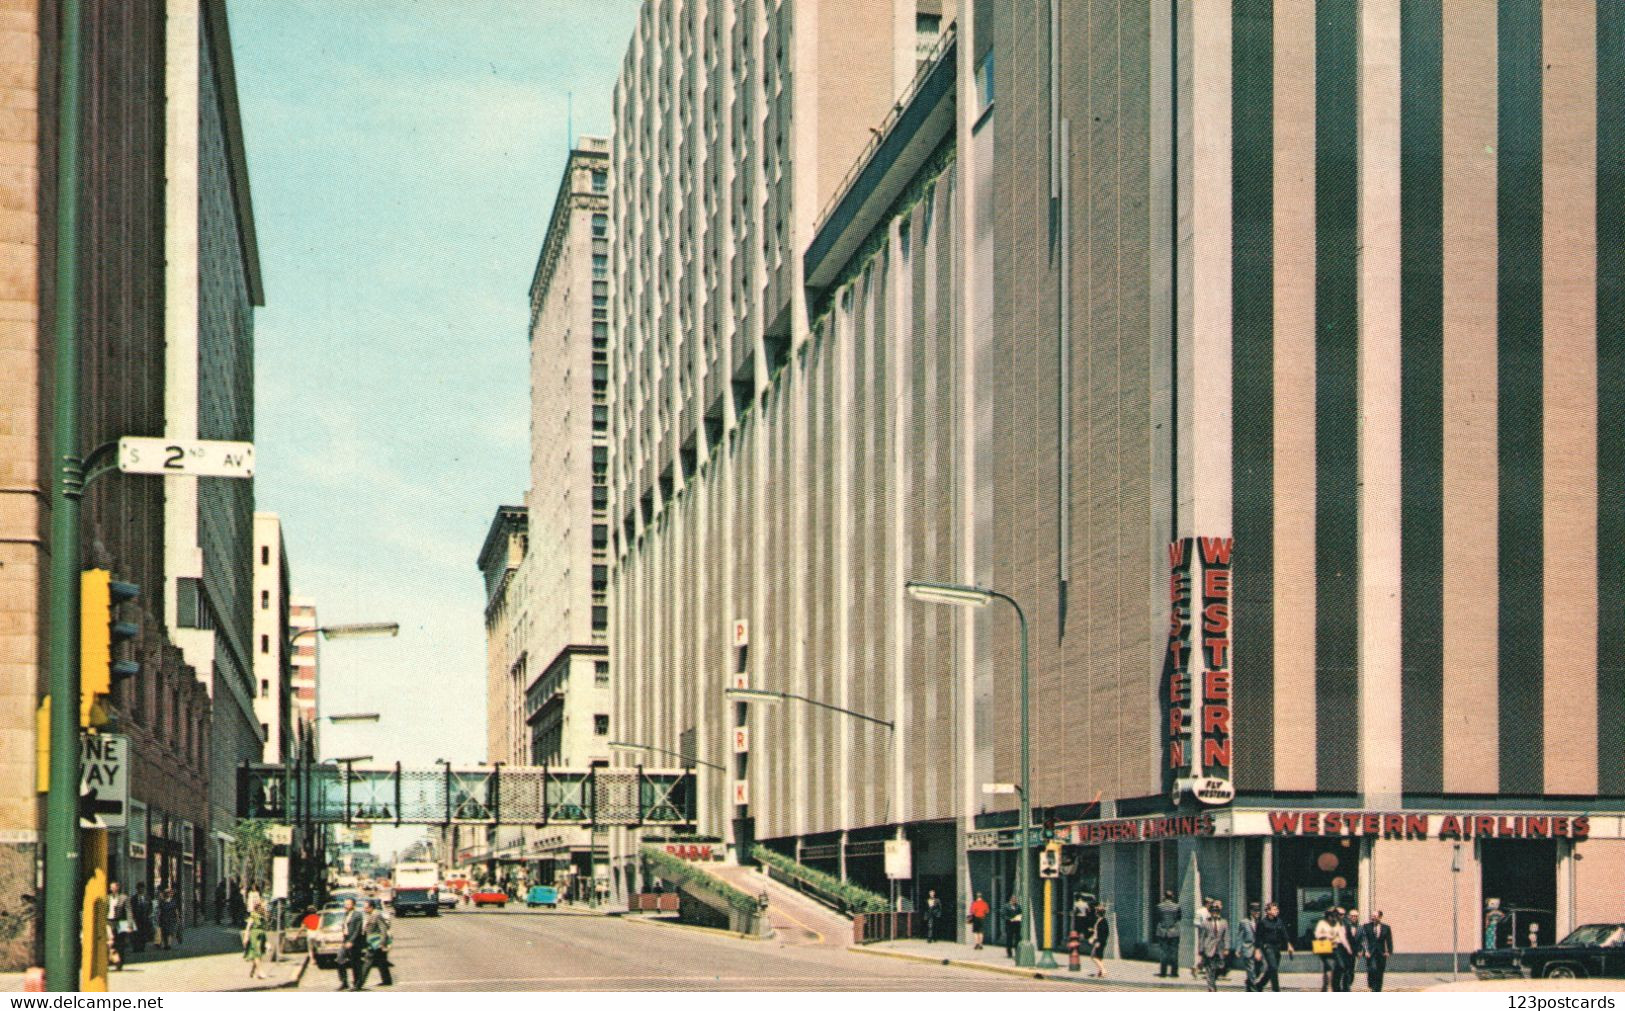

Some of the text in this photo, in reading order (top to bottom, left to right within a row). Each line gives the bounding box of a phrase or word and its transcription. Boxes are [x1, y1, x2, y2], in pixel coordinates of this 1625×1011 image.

[129, 447, 140, 464] S
[223, 453, 244, 467] AV
[1168, 539, 1185, 769] WESTERN
[1200, 536, 1233, 767] WESTERN
[80, 740, 118, 760] NE
[1198, 789, 1232, 799] WESTERN
[1205, 780, 1223, 789] FLY
[1078, 819, 1139, 843] WESTERN
[1142, 813, 1215, 839] AIRLINES
[1268, 811, 1591, 840] WESTERN AIRLINES
